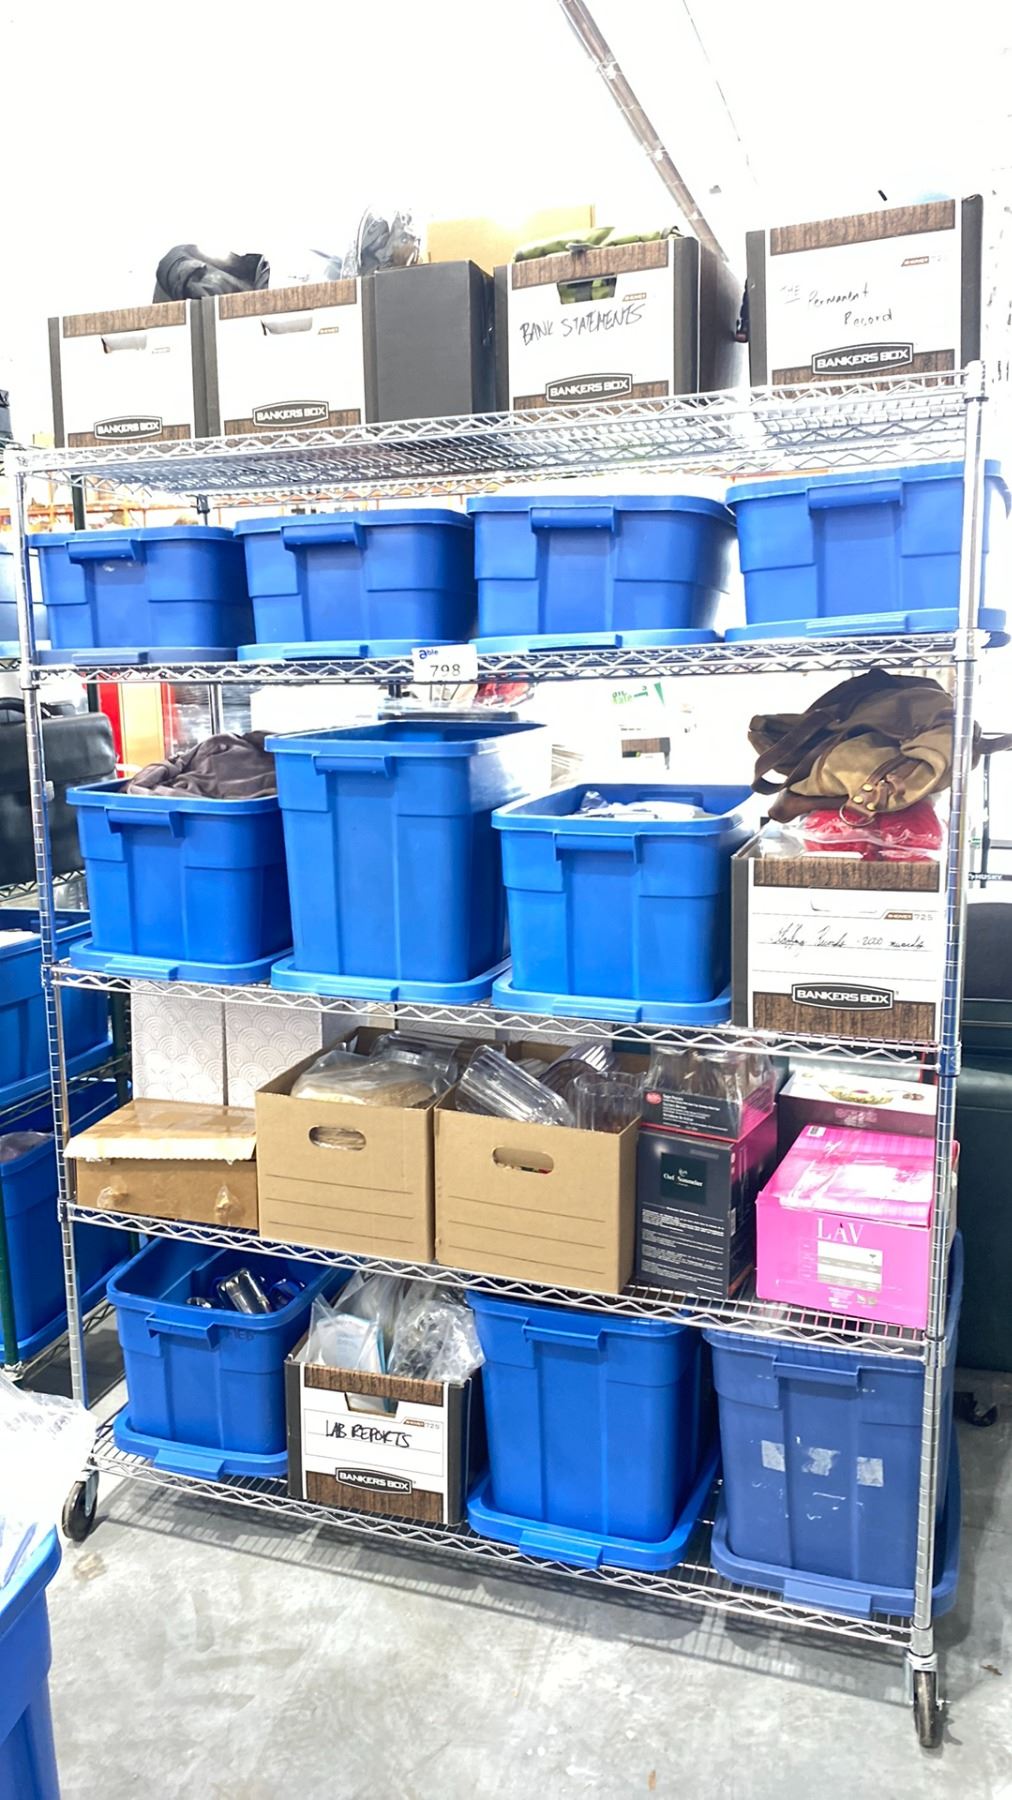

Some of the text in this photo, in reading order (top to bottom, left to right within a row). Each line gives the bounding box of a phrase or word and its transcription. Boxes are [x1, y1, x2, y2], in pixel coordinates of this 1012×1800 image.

[519, 303, 646, 346] BANK STATEMENTS
[844, 308, 893, 326] Record
[817, 349, 909, 369] BANKERS BOX
[549, 379, 629, 397] BANKERS BOX
[256, 406, 325, 421] BANKERS BOX
[97, 421, 160, 434] BANKERS BOX
[430, 663, 461, 678] 798
[914, 913, 934, 921] 725
[797, 990, 889, 1004] BANKERS BOX
[817, 1217, 865, 1245] LAV
[325, 1419, 413, 1448] LAB REPORTS
[339, 1472, 410, 1491] BANKERS BOX
